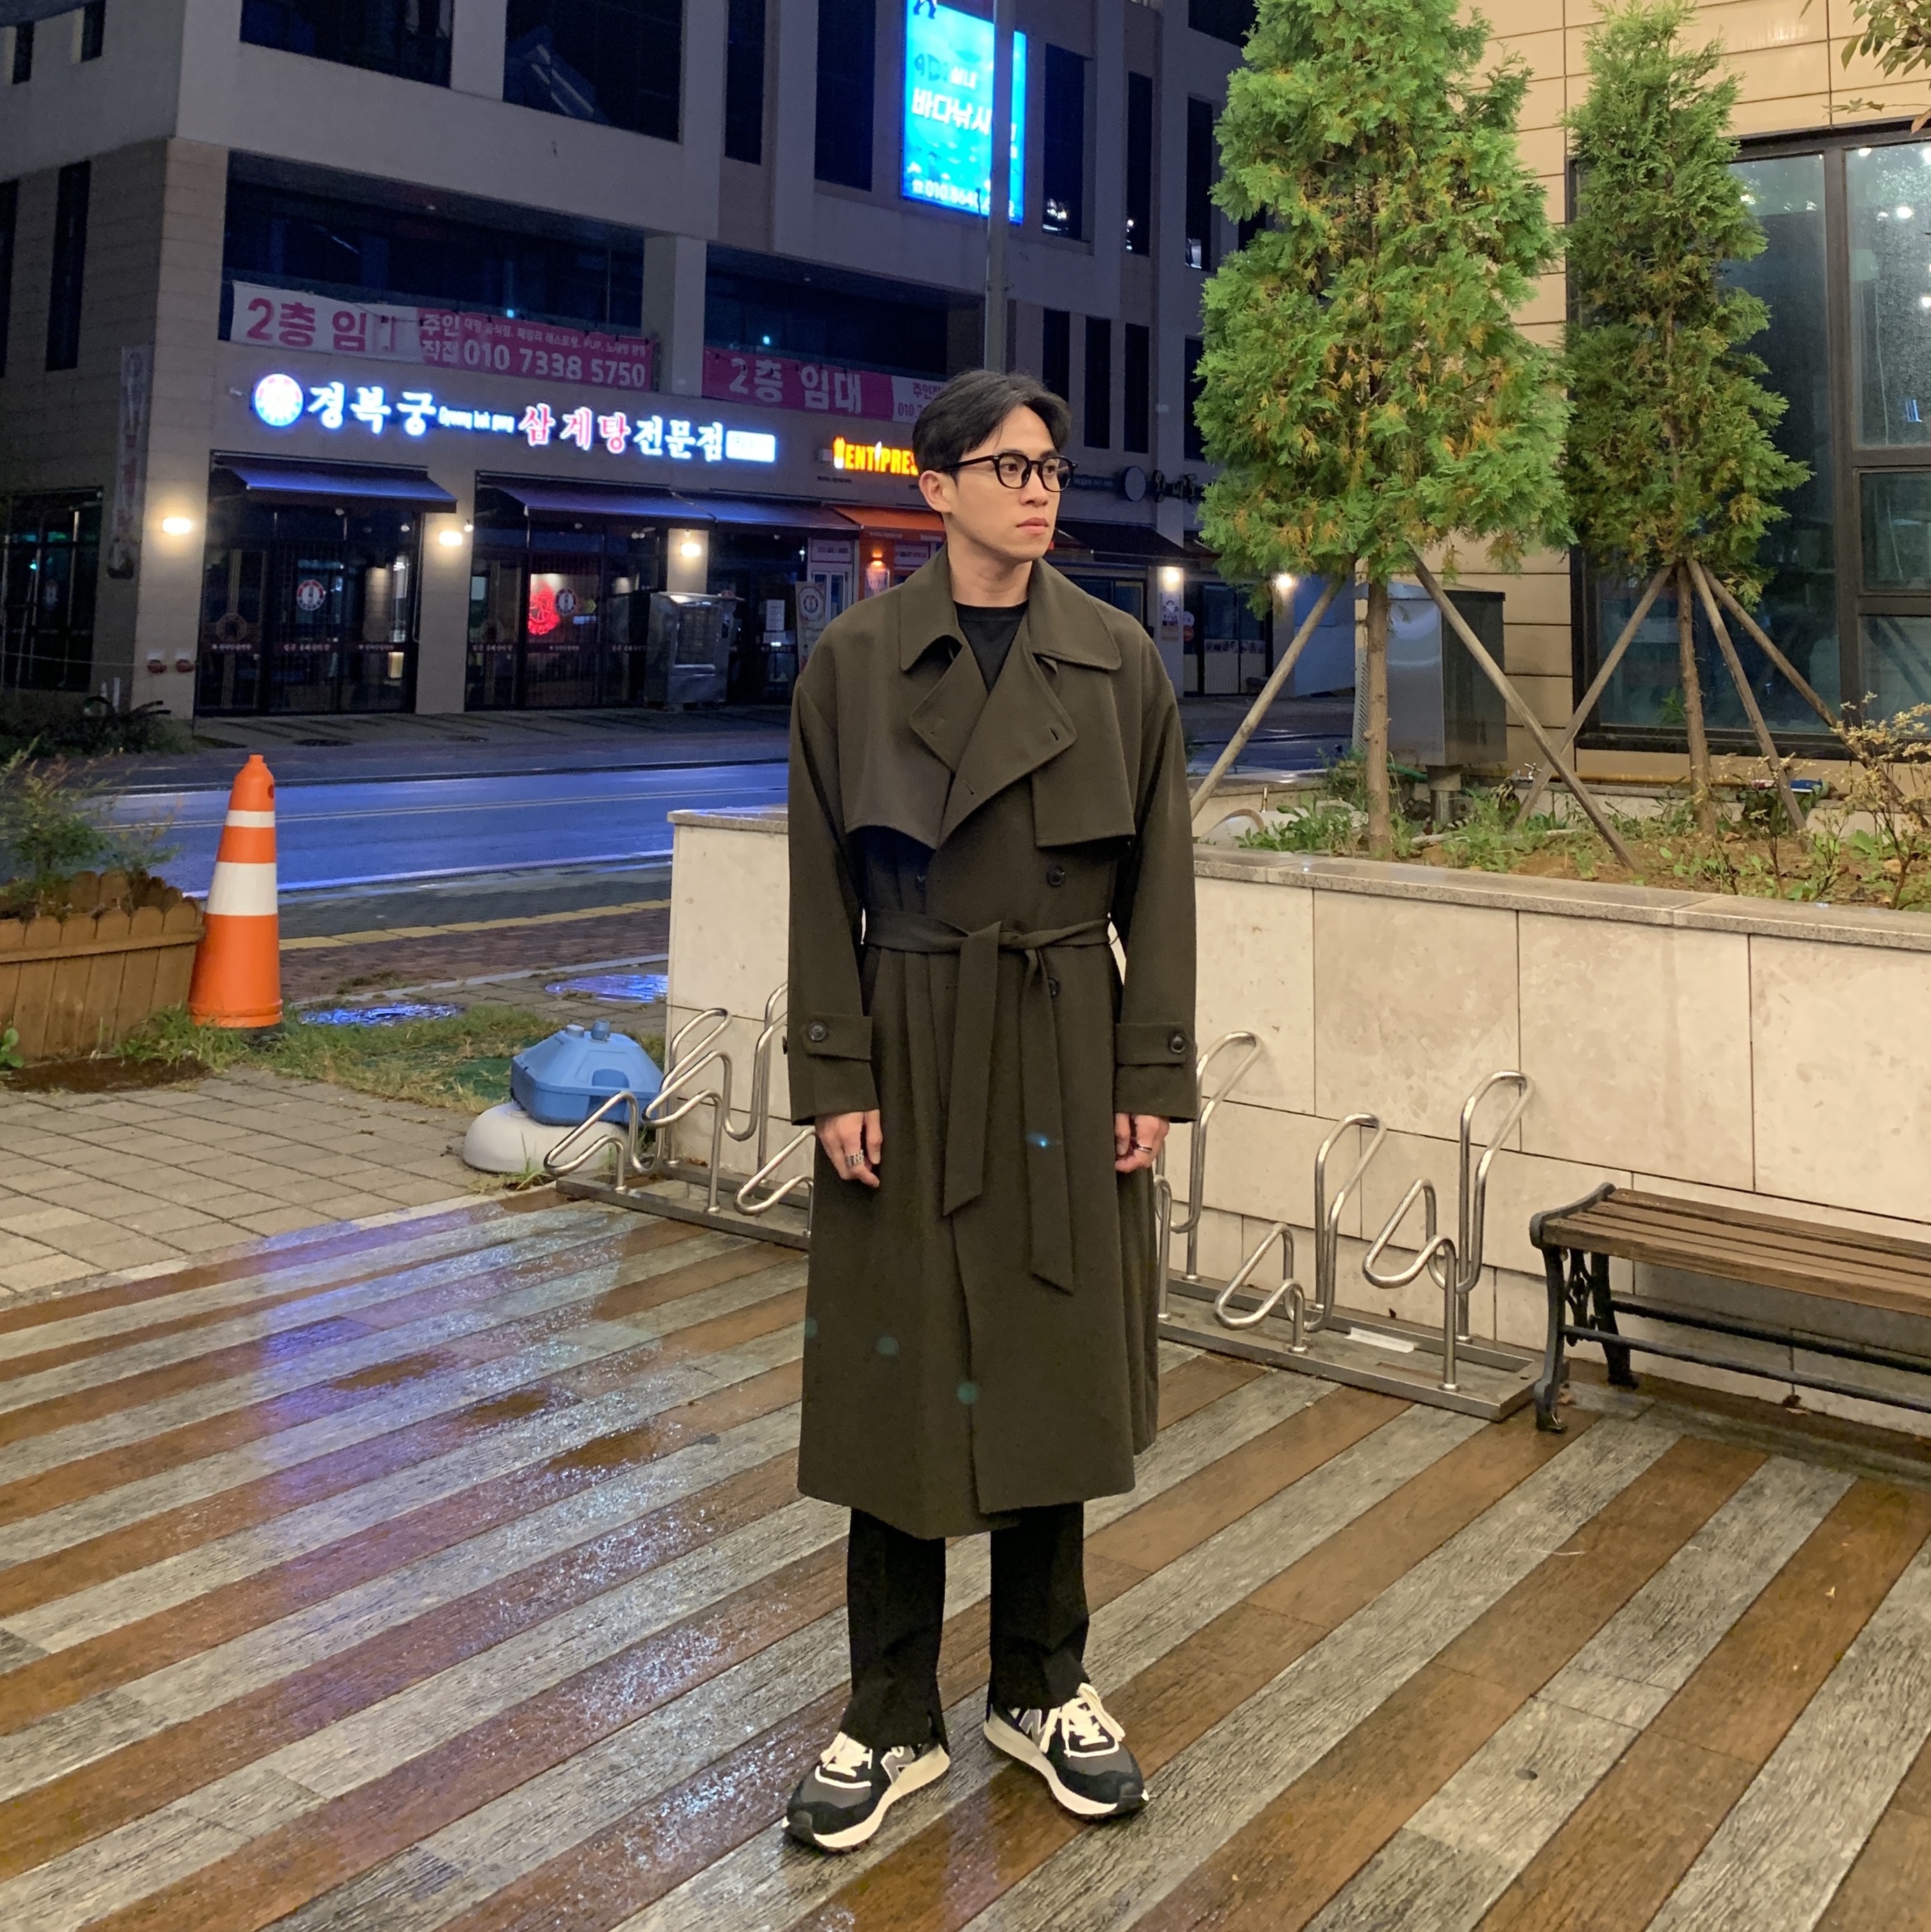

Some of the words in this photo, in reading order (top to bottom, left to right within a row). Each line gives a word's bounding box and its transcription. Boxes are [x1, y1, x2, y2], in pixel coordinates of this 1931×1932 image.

[247, 298, 316, 348] 2층
[421, 314, 460, 336] 주인
[464, 339, 511, 370] 010
[520, 348, 583, 380] 7338
[591, 359, 646, 387] 5750
[729, 358, 784, 403] 2층
[800, 366, 862, 415] 임대
[308, 382, 437, 436] 경복궁
[518, 403, 632, 455] 삼계탕
[633, 415, 723, 462] 전문점
